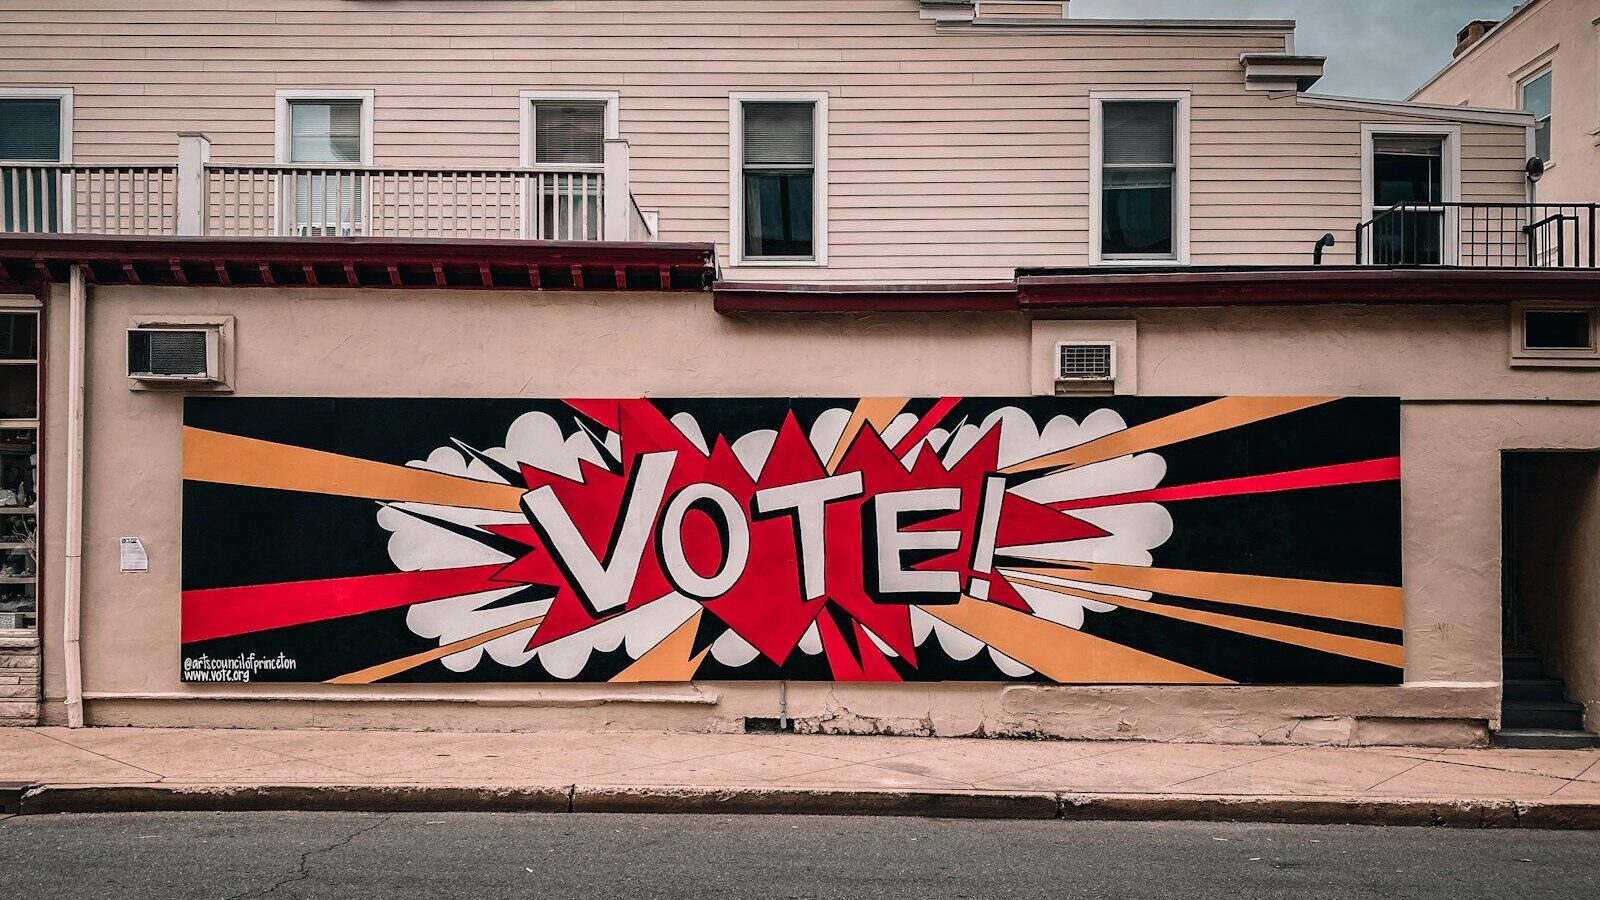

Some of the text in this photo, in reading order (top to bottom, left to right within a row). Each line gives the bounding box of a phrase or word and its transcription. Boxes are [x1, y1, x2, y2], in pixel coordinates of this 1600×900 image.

[520, 450, 1007, 617] VOTE!
[184, 652, 297, 674] @artscouncilofprinceton
[184, 669, 250, 682] www.vote.org
